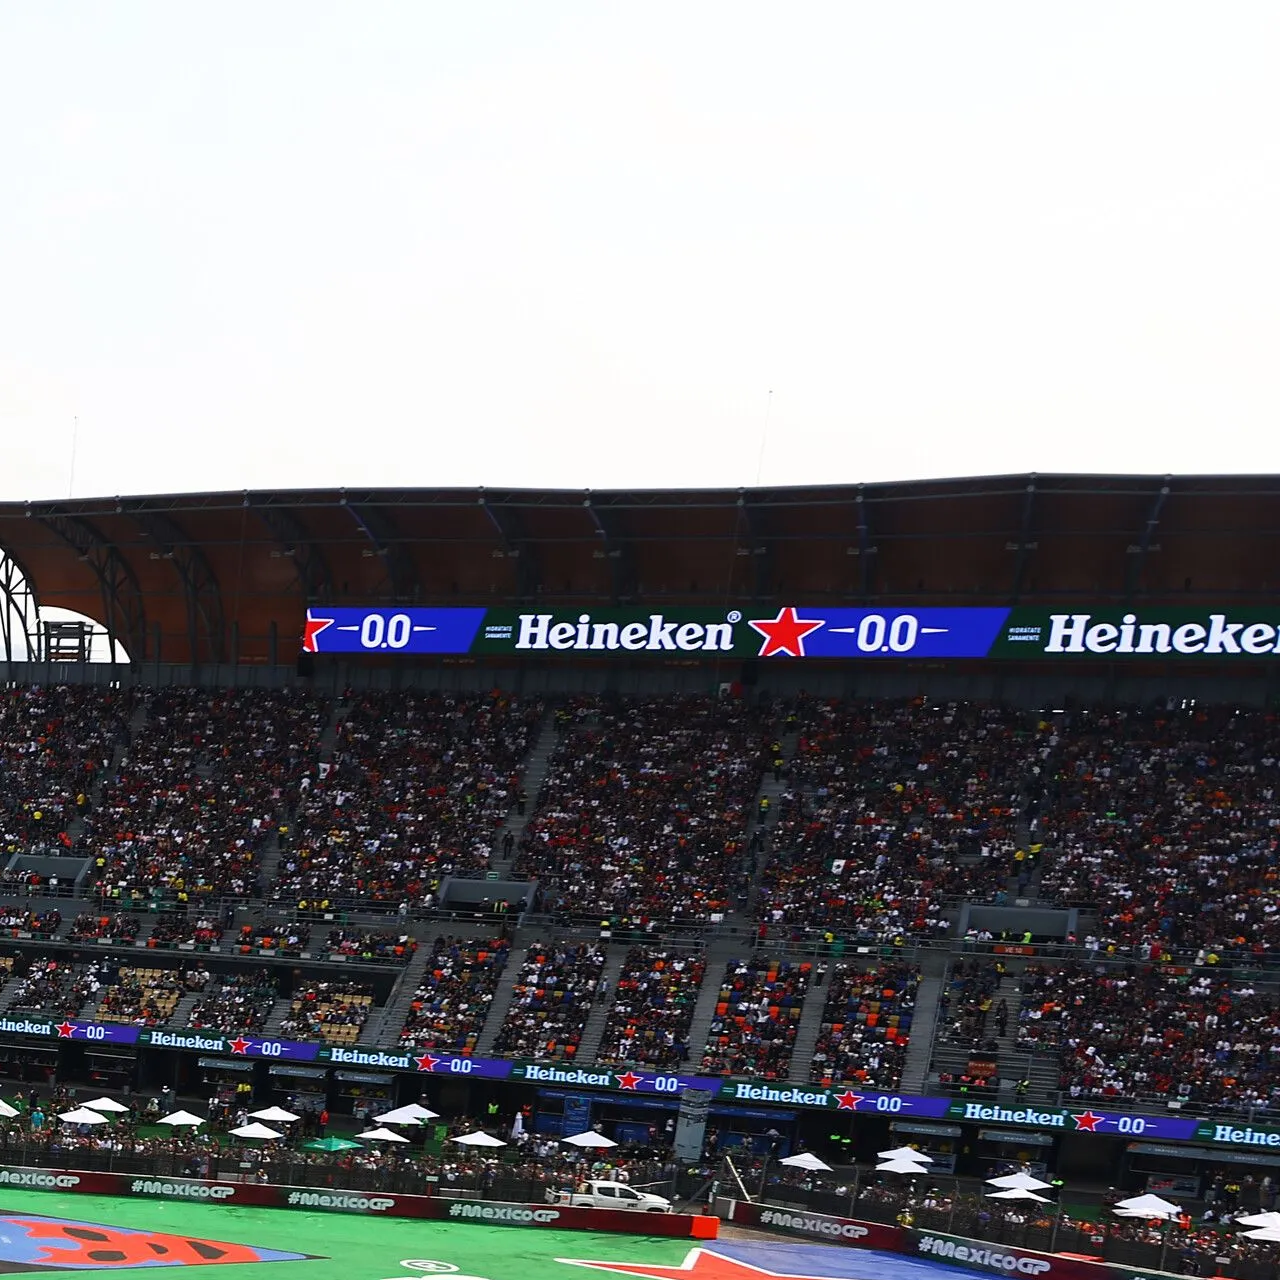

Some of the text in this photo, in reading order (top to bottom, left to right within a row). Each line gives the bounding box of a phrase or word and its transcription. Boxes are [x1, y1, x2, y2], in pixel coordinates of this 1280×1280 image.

[361, 613, 411, 649] 0.0
[857, 614, 917, 652] 0.0
[150, 1031, 223, 1051] Heineken
[330, 1047, 409, 1068] Heineken
[525, 1065, 610, 1085] Heineken
[735, 1084, 828, 1106] Heineken
[877, 1096, 902, 1112] 0.0
[964, 1104, 1065, 1126] Heineken
[1118, 1117, 1144, 1133] 0.0
[132, 1178, 236, 1199] #MexicoGP
[288, 1192, 395, 1211] #MexicoGP
[449, 1204, 560, 1224] #MexicoGP
[760, 1211, 869, 1239] #MexicoGP
[918, 1236, 1051, 1275] #MexicoGP
